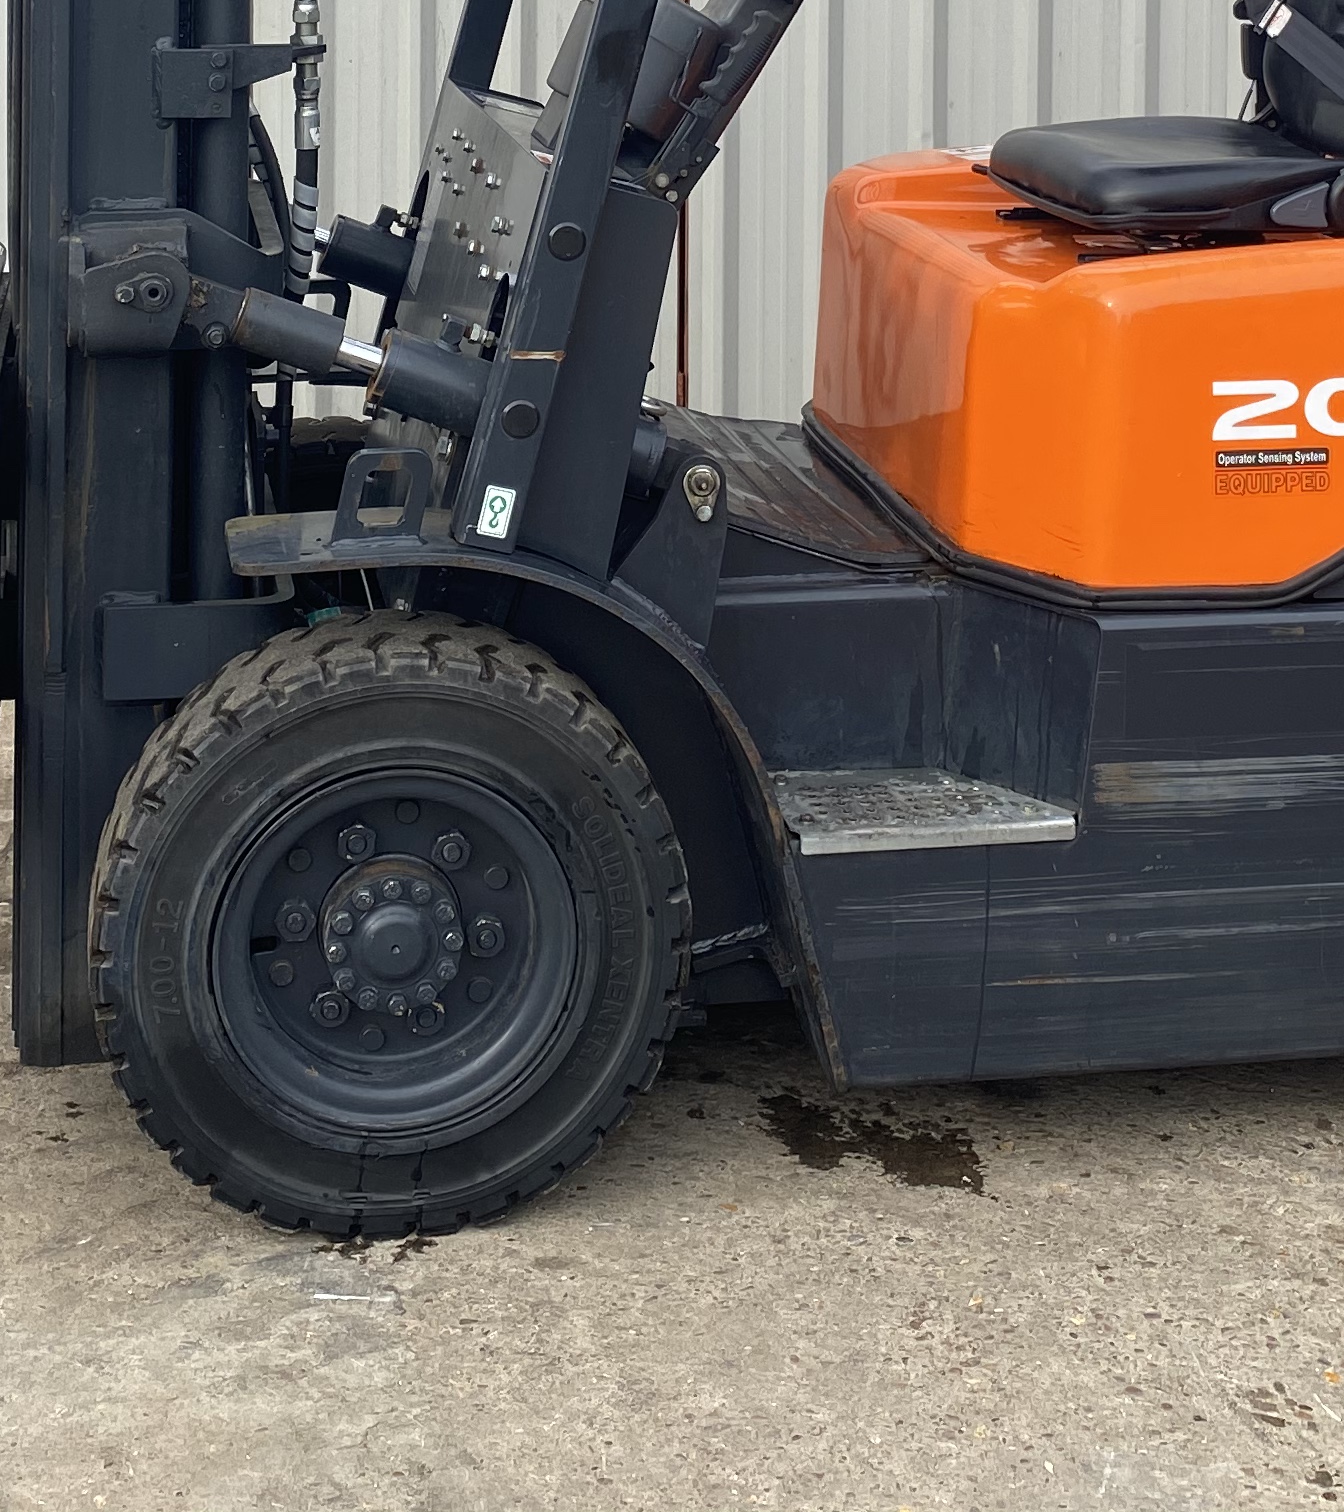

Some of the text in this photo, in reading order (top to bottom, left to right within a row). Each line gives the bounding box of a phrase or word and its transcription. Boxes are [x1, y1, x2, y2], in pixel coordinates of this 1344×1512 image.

[1215, 471, 1330, 496] EQUIPPED
[1218, 451, 1327, 466] Operator Sensing System
[150, 898, 185, 1025] 7.00-12
[565, 795, 636, 1083] SOLIDEAL XENTRA
